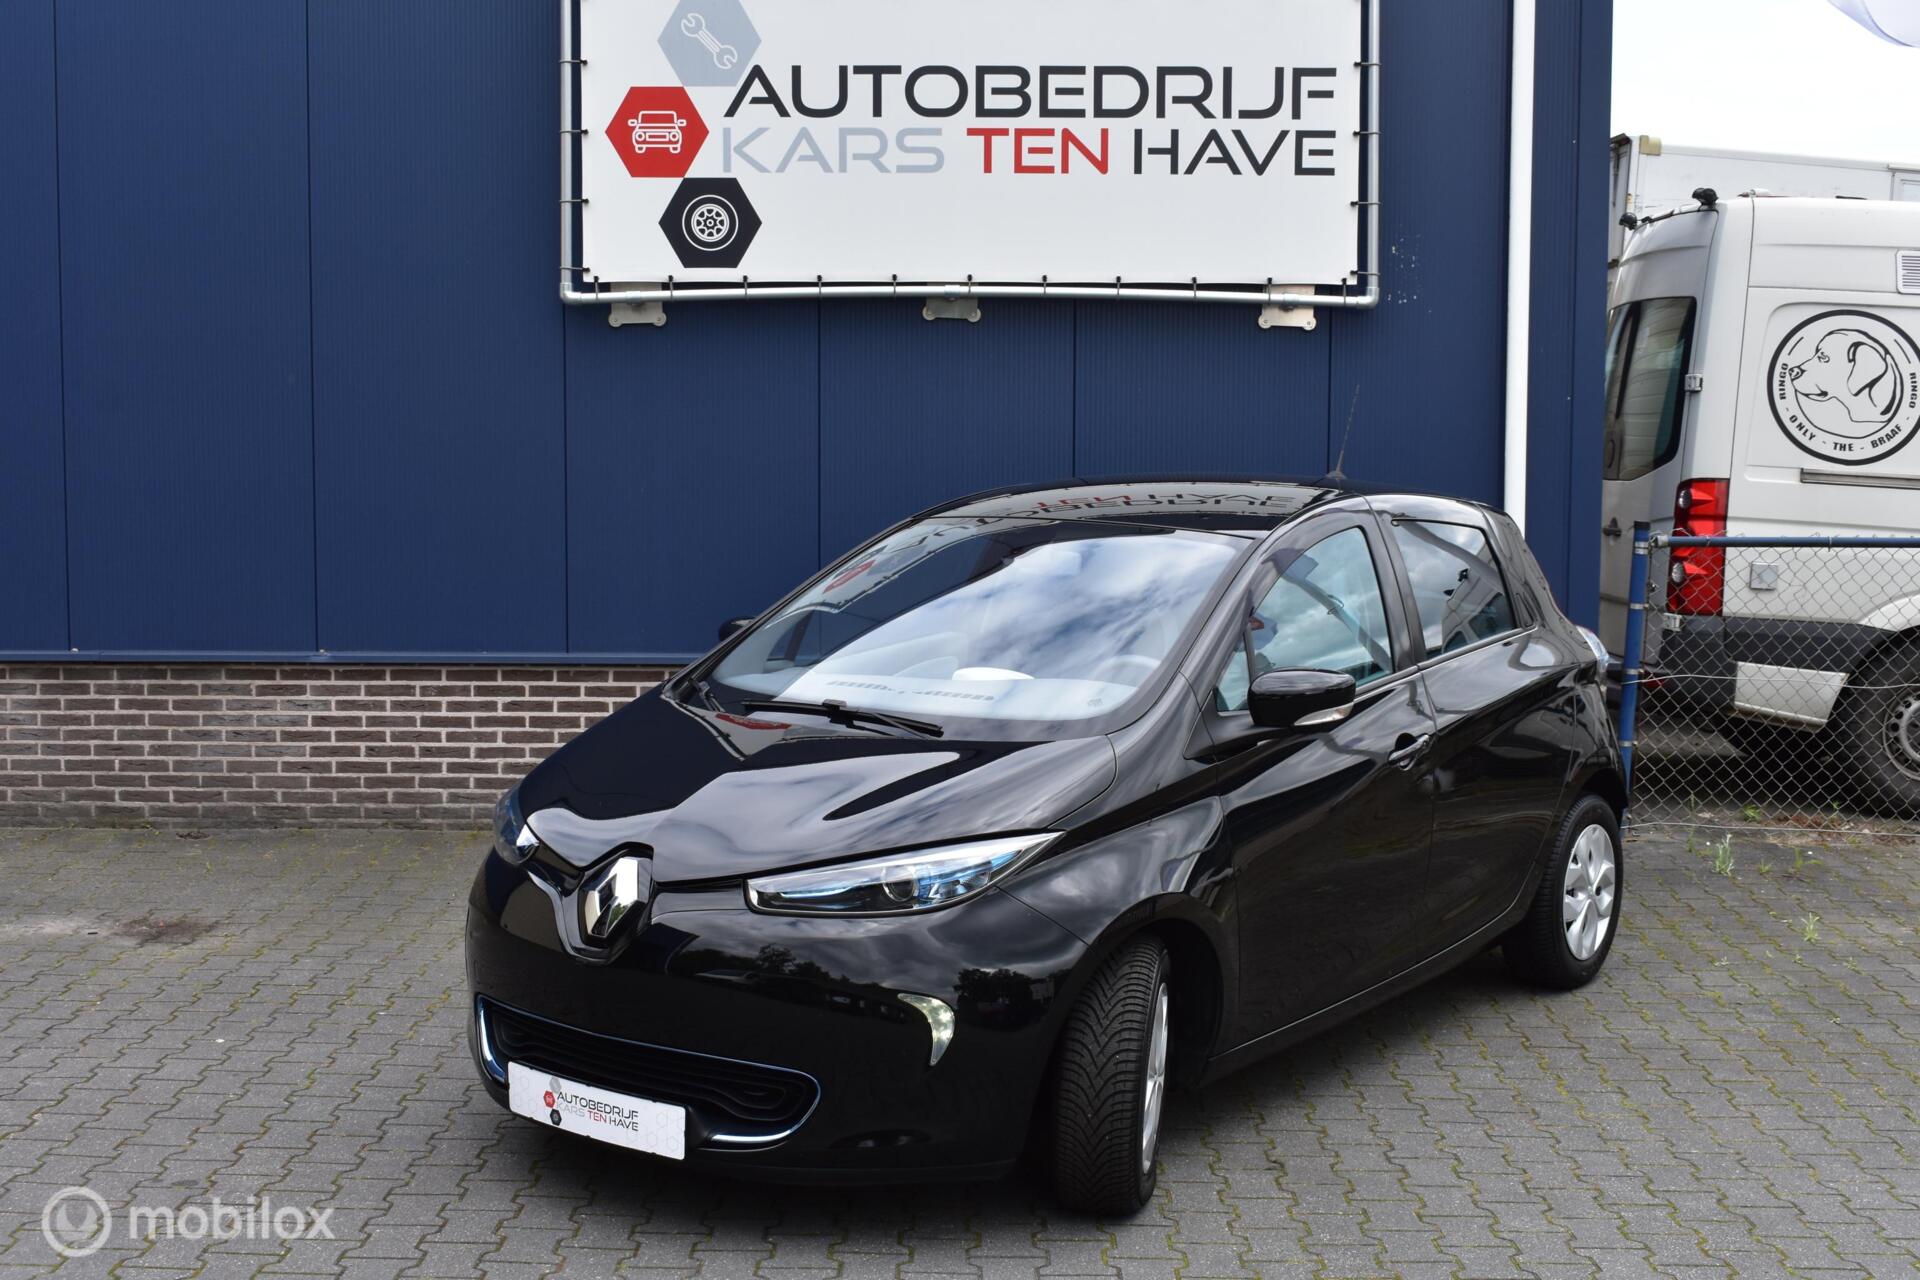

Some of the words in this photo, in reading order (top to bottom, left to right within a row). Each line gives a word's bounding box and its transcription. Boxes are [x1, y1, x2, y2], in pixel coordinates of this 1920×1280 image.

[723, 64, 1337, 120] AUTOBEDRIJF
[722, 126, 945, 174] KARS
[966, 127, 1110, 176] TEN
[1133, 128, 1337, 176] HAVE
[1778, 362, 1789, 400] RINGO
[1788, 414, 1816, 442] ONLY
[1833, 441, 1854, 452] THE
[1870, 423, 1902, 449] BRAAF
[1909, 372, 1917, 409] RINGO
[557, 1091, 639, 1120] AUTOBEDRIJF
[557, 1102, 585, 1117] KARS
[587, 1109, 607, 1124] TEN
[608, 1115, 639, 1131] HAVE
